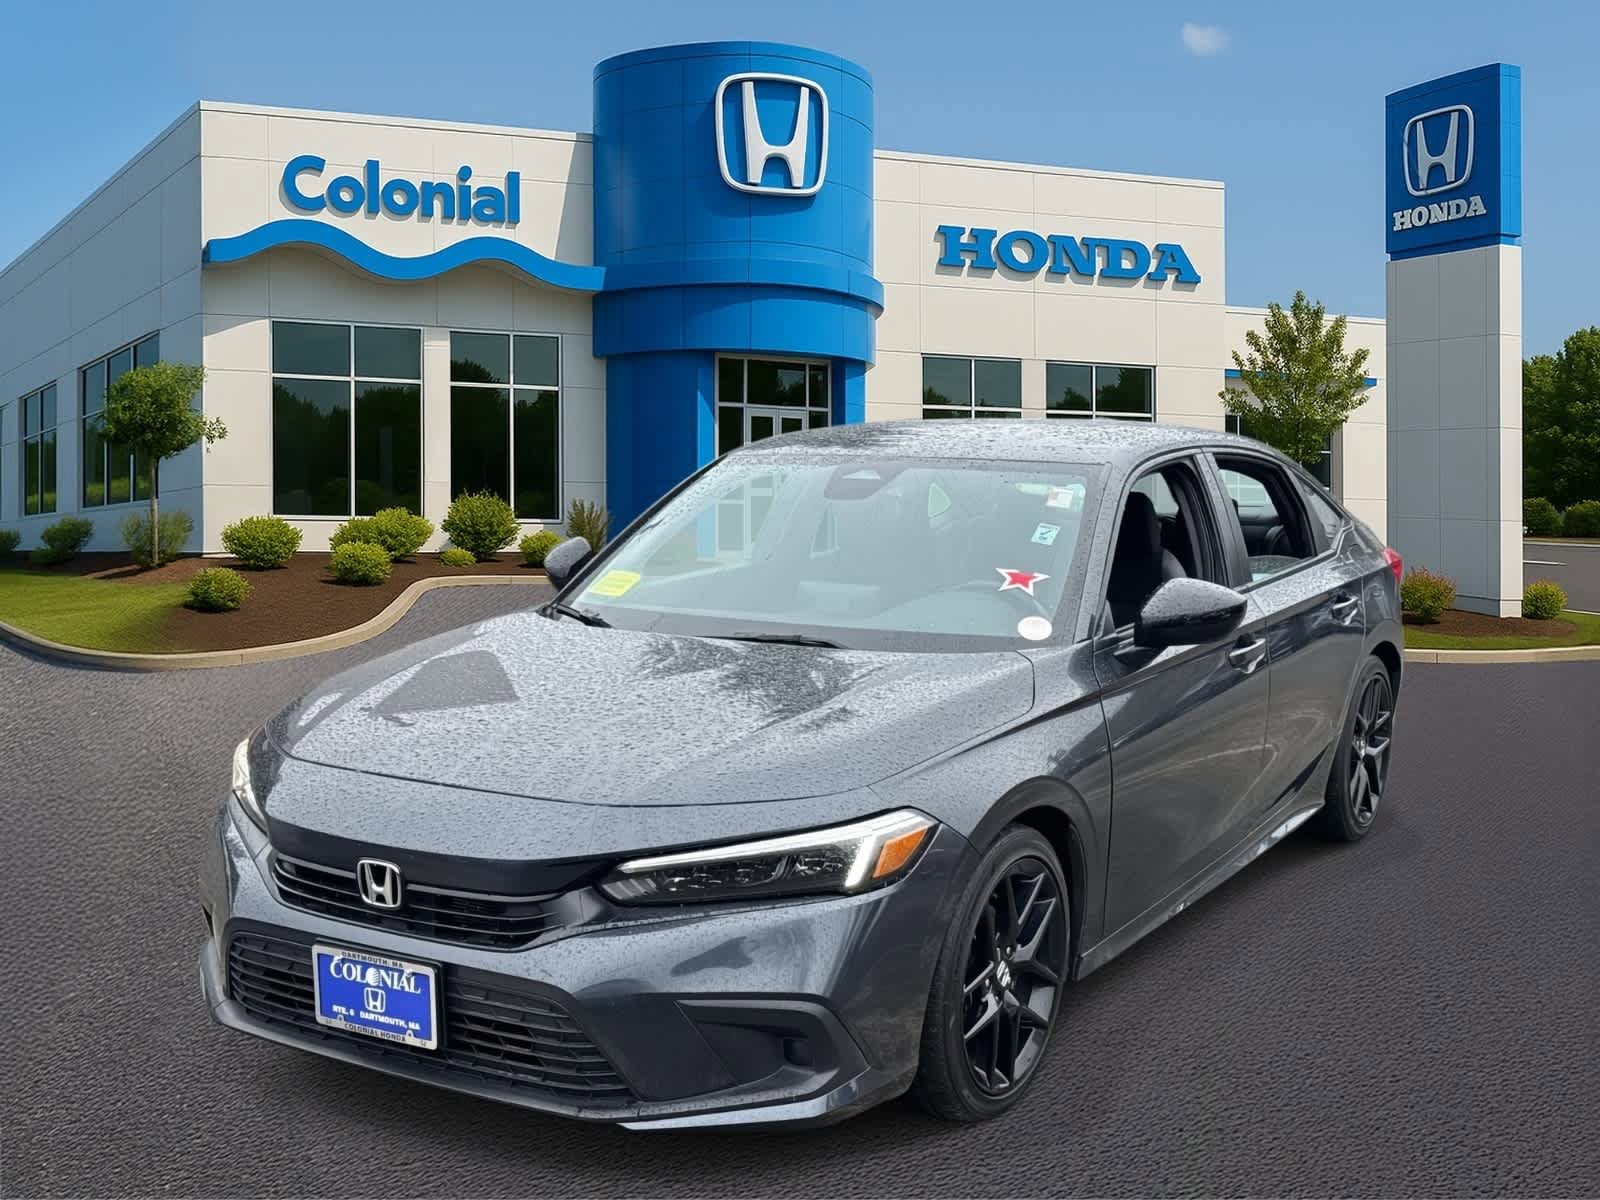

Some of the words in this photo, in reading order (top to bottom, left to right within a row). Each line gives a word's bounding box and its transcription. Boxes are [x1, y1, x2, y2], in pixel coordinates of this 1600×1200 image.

[283, 154, 521, 225] Colonial
[1392, 195, 1487, 231] HONDA
[936, 224, 1202, 284] HONDA
[330, 956, 421, 994] COLONIAL
[345, 1023, 378, 1037] COLONIAL
[381, 1031, 406, 1042] HONDA
[408, 1021, 421, 1030] MA
